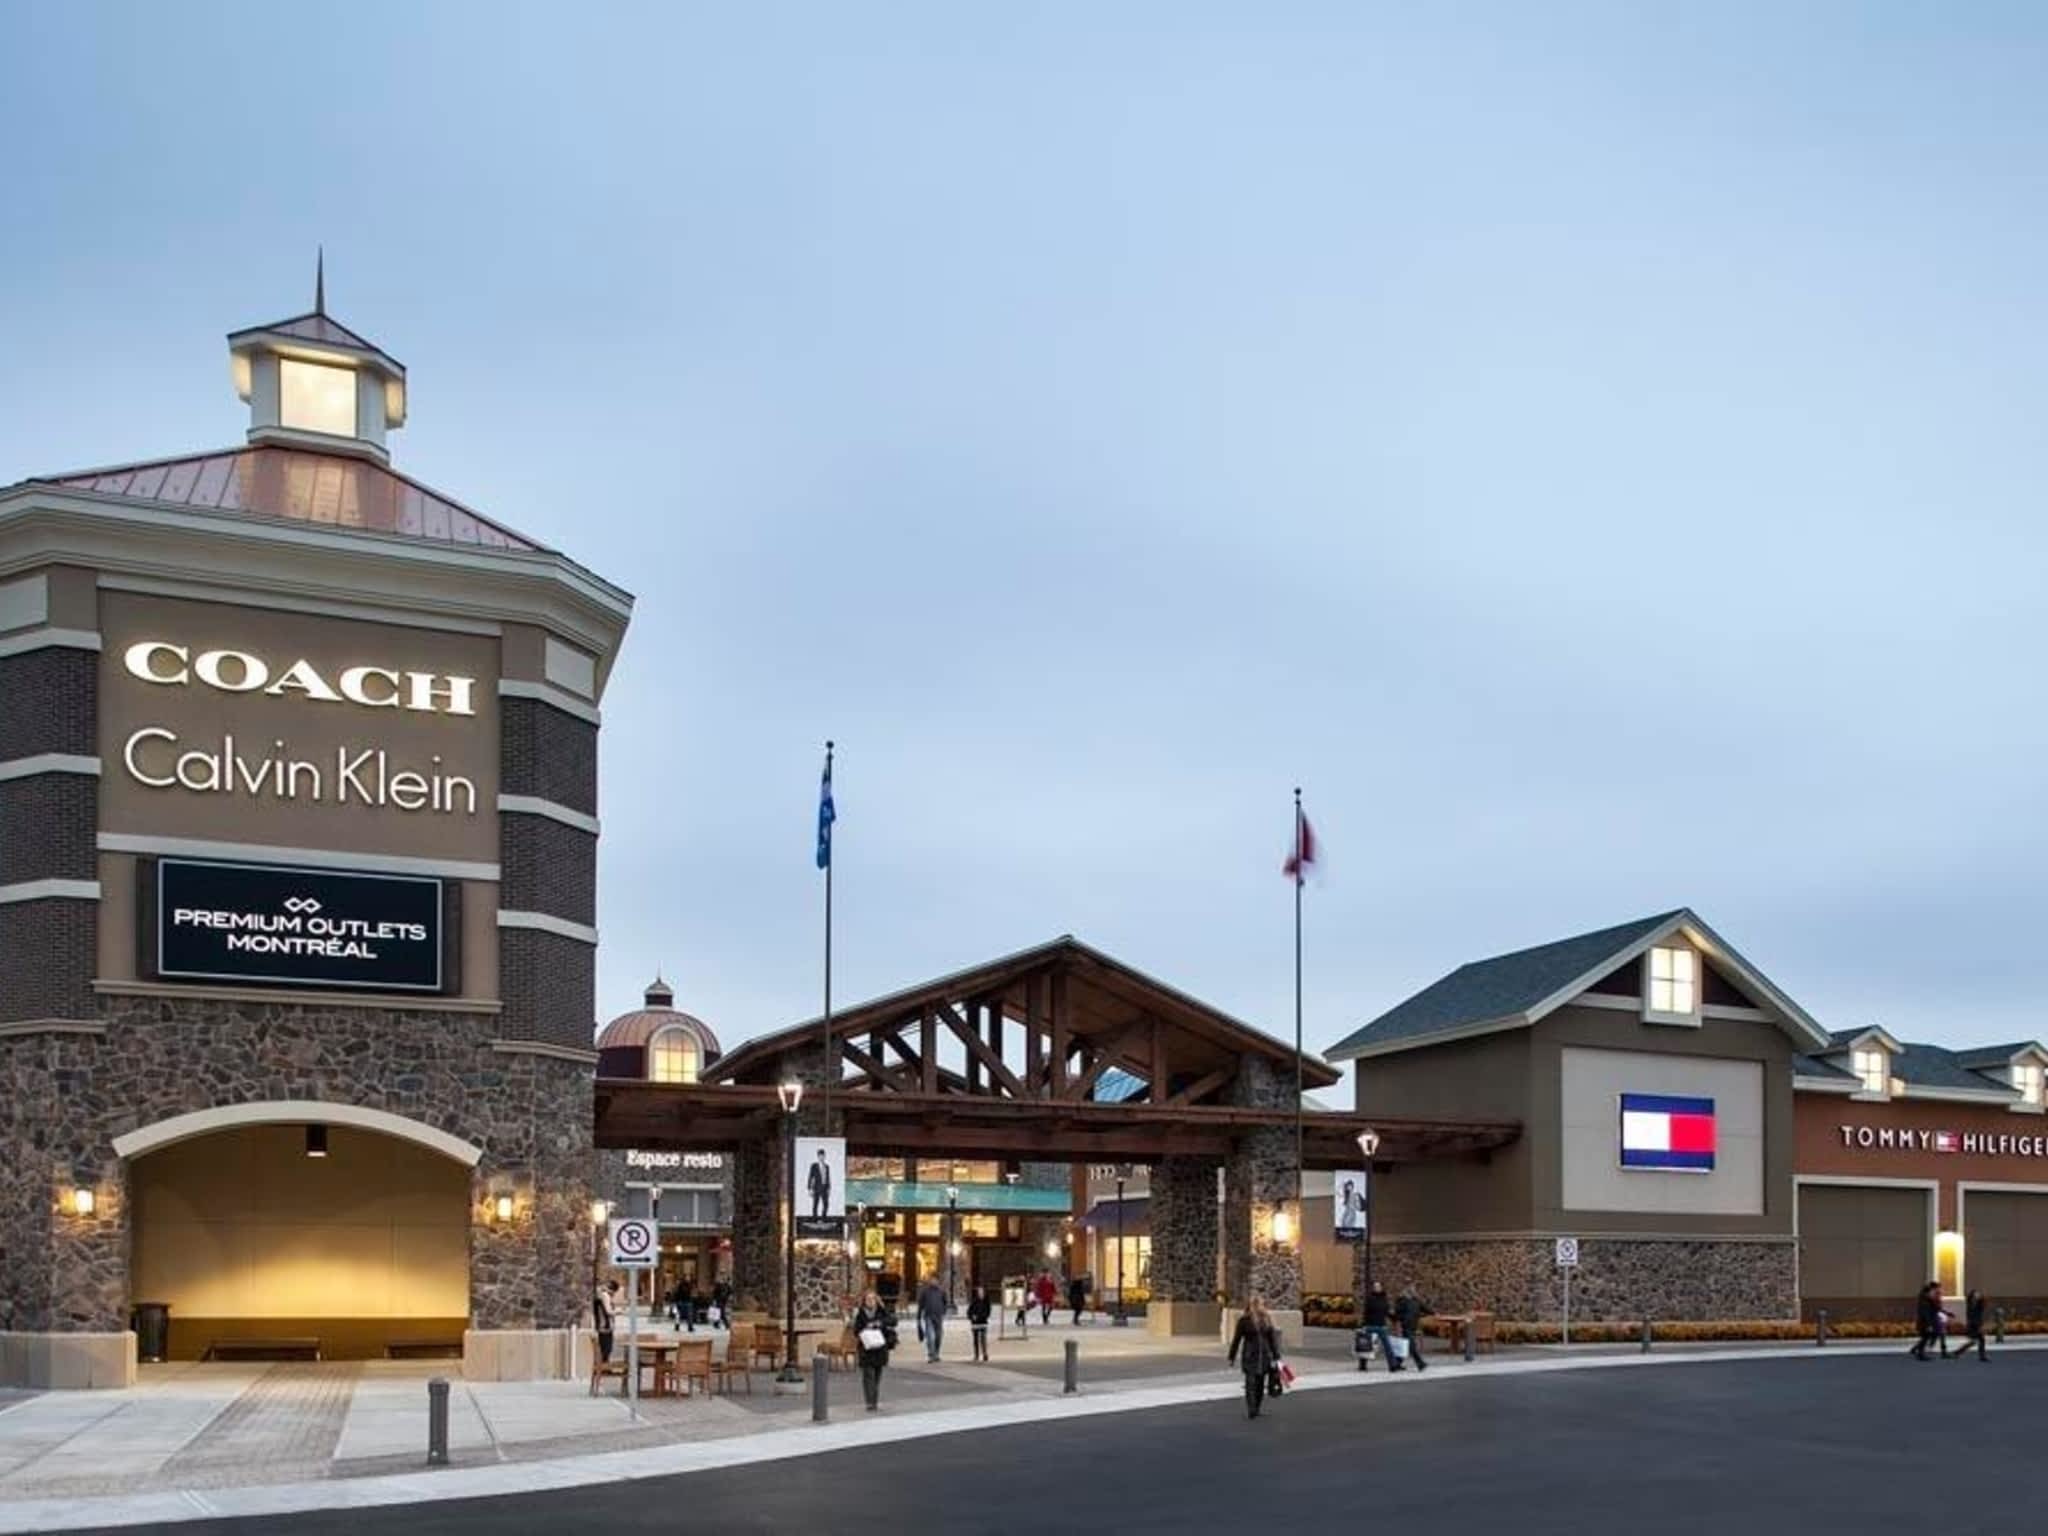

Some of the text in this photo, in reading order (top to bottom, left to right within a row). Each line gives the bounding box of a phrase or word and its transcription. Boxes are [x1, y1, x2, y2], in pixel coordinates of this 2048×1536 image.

[124, 641, 476, 716] COACH
[124, 727, 476, 814] Calvin Klein
[173, 908, 427, 941] PREMIUM OUTLETS
[227, 933, 378, 959] MONTRÉAL
[1840, 1125, 1930, 1149] TOMMY
[627, 1149, 723, 1170] Espace resto
